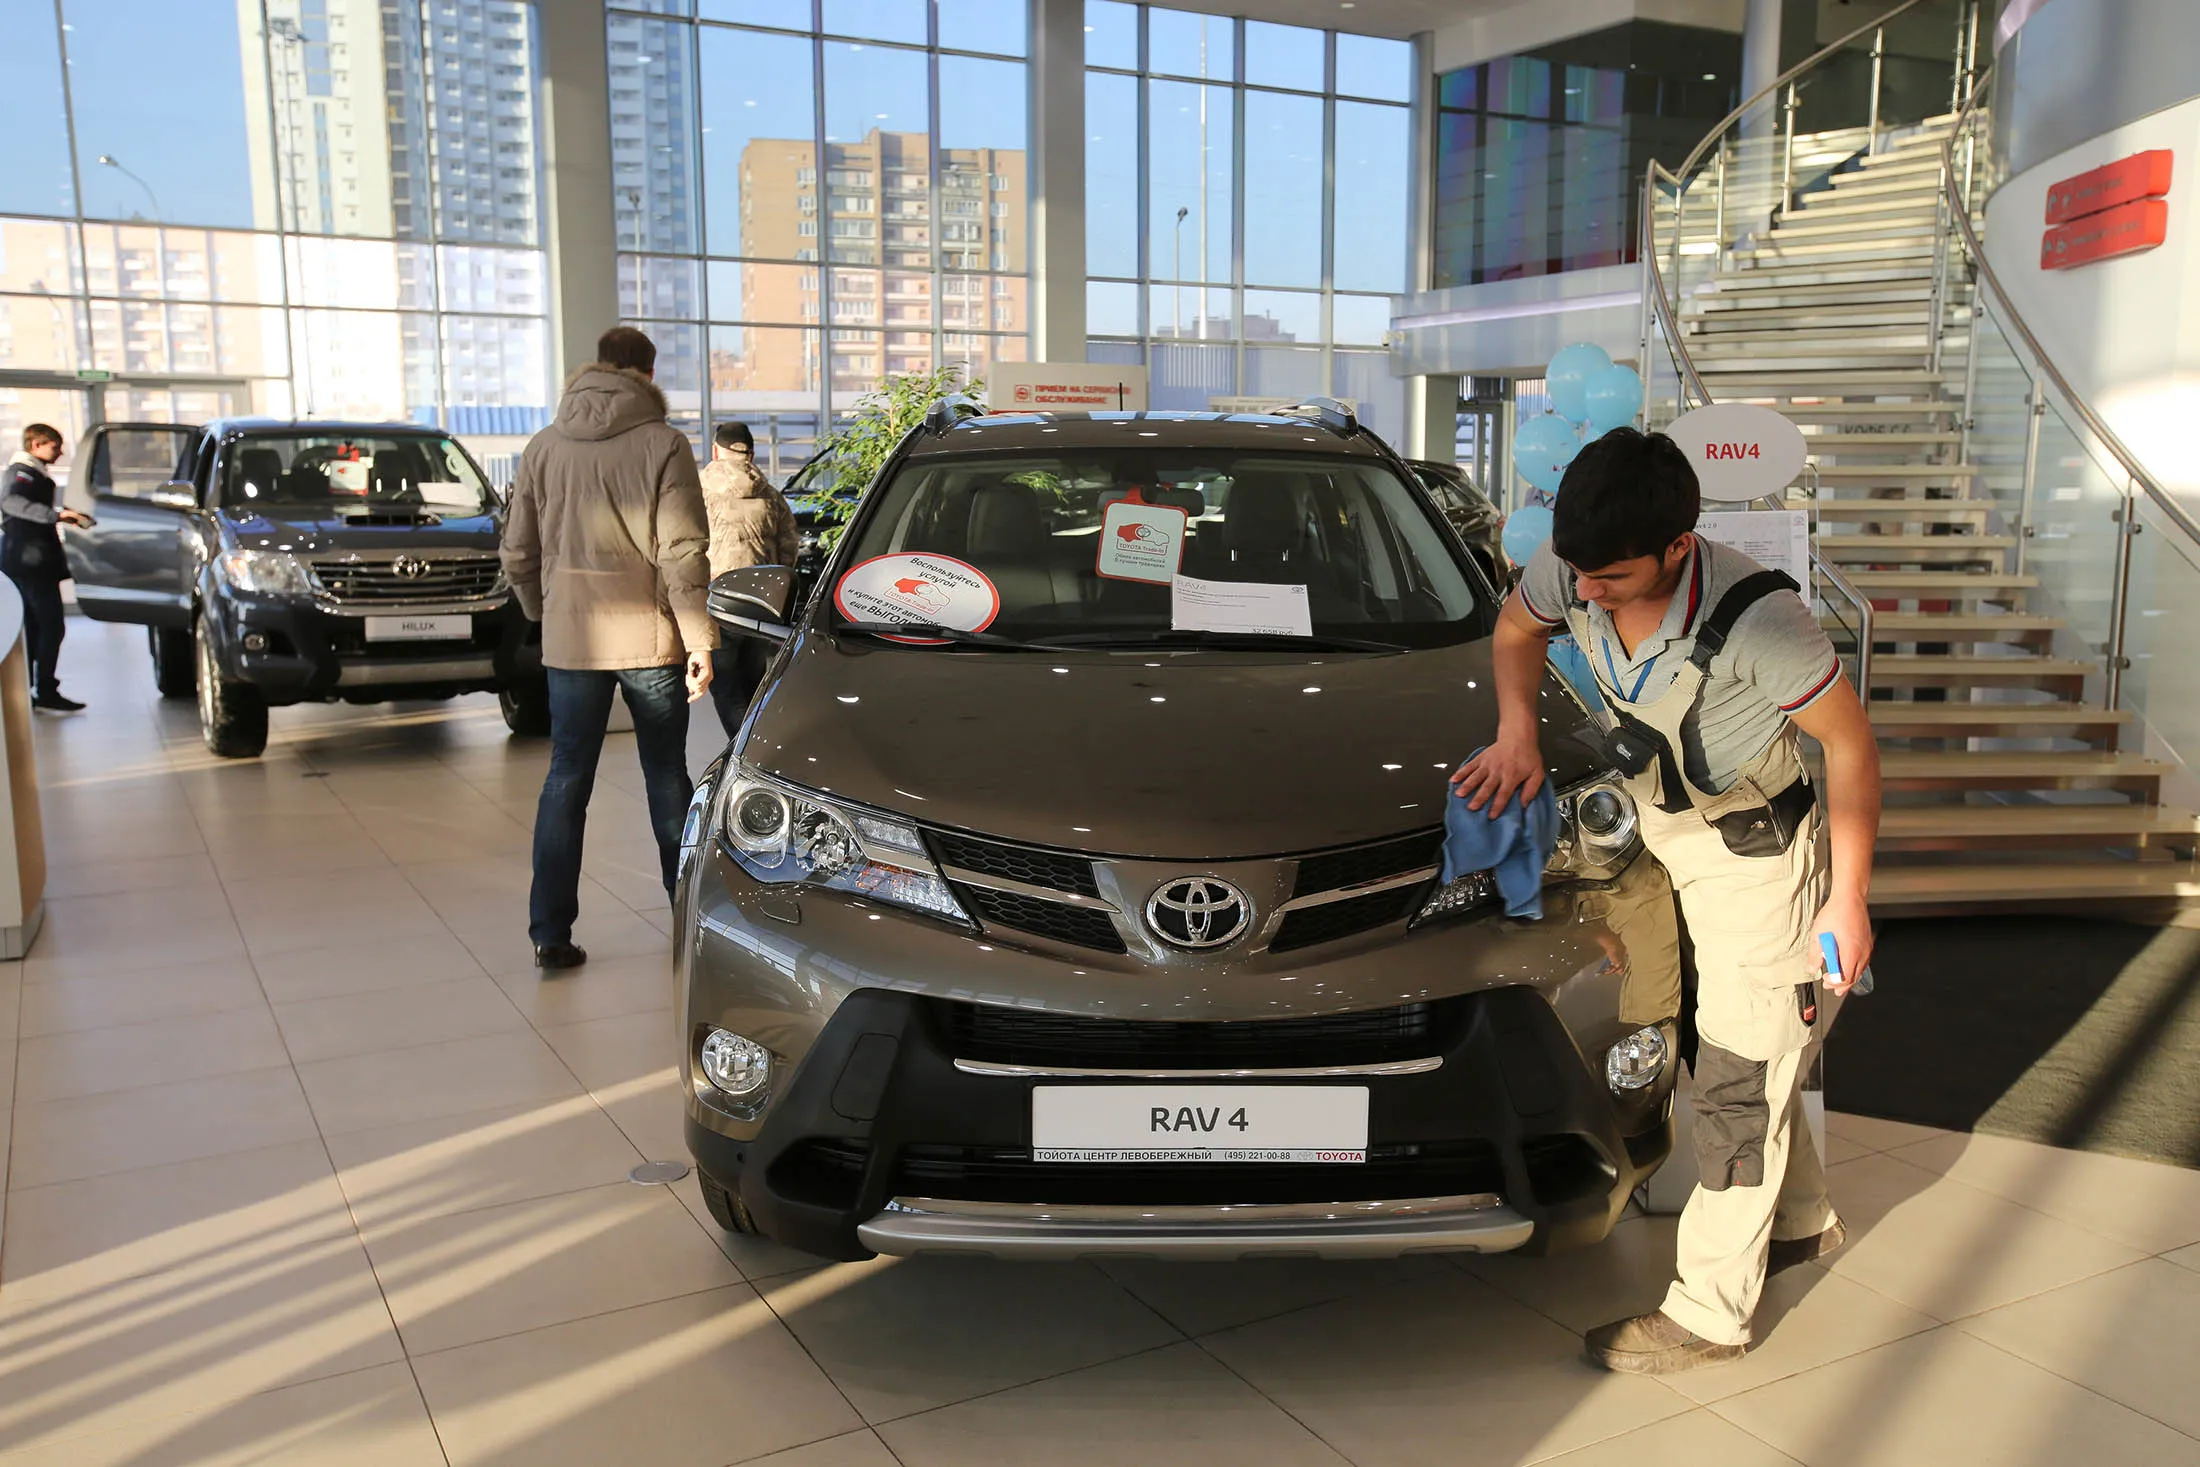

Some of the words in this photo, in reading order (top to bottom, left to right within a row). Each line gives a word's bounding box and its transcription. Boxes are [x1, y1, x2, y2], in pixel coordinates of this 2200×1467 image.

[1705, 443, 1761, 460] RAV4
[1119, 542, 1142, 551] TOYOTA
[910, 557, 981, 589] Воспользуйтесь
[918, 571, 958, 589] услугой
[853, 591, 883, 605] купите
[882, 601, 903, 612] этот
[887, 591, 911, 603] TOYOTA
[402, 622, 436, 632] HILUX
[1151, 1107, 1221, 1132] RAV
[1228, 1107, 1249, 1132] 4
[1037, 1150, 1081, 1160] ТОЙОТА
[1083, 1152, 1118, 1161] ЦЕНТР
[1120, 1151, 1212, 1160] ЛЕВОБЕРЕЖНЫЙ
[1224, 1152, 1246, 1161] (495)
[1248, 1152, 1291, 1160] 221-00-88
[1315, 1152, 1363, 1161] TOYOTA
